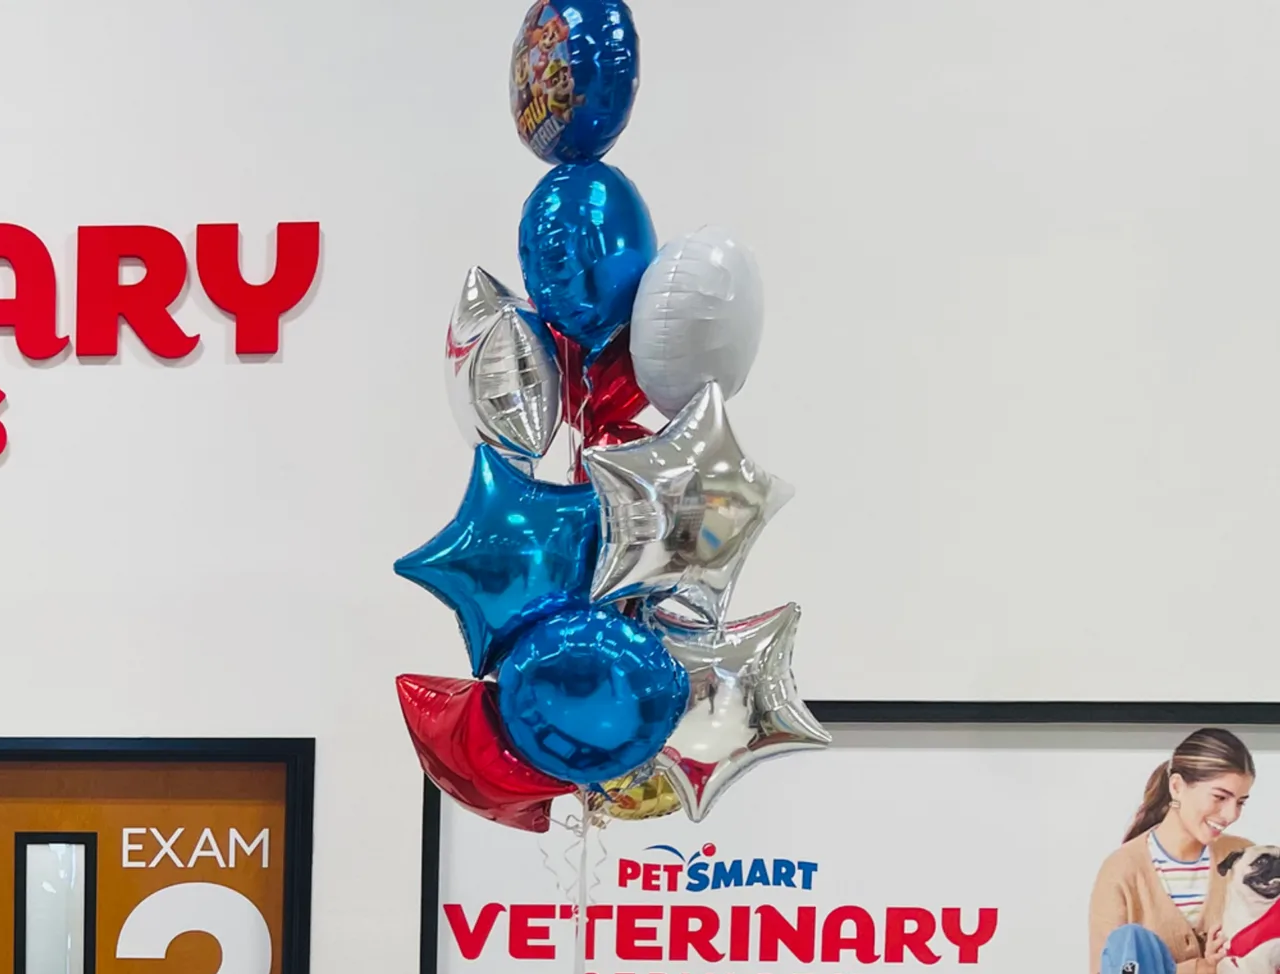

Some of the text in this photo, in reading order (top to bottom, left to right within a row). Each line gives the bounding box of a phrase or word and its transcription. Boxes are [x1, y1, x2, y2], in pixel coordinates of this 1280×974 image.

[121, 827, 270, 869] EXAM
[618, 858, 818, 893] PETSMART
[443, 902, 998, 965] VETERINARY
